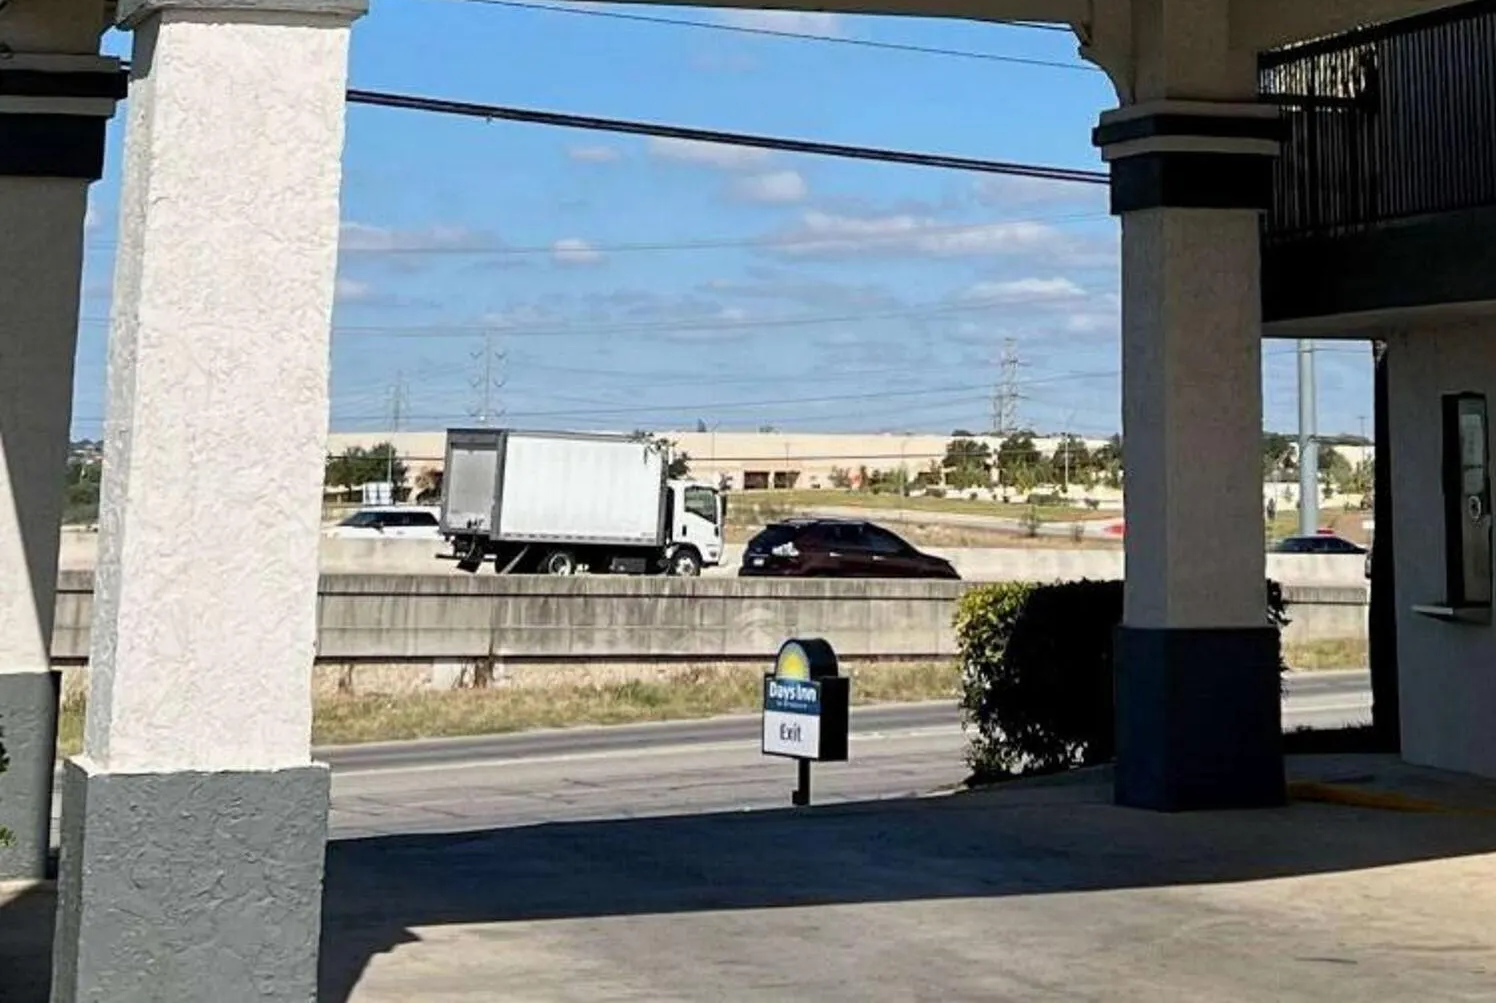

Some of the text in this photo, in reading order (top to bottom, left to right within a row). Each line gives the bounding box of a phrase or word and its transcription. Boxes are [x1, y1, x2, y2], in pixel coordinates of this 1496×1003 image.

[769, 681, 817, 702] Days Inn
[780, 722, 801, 742] Exit
